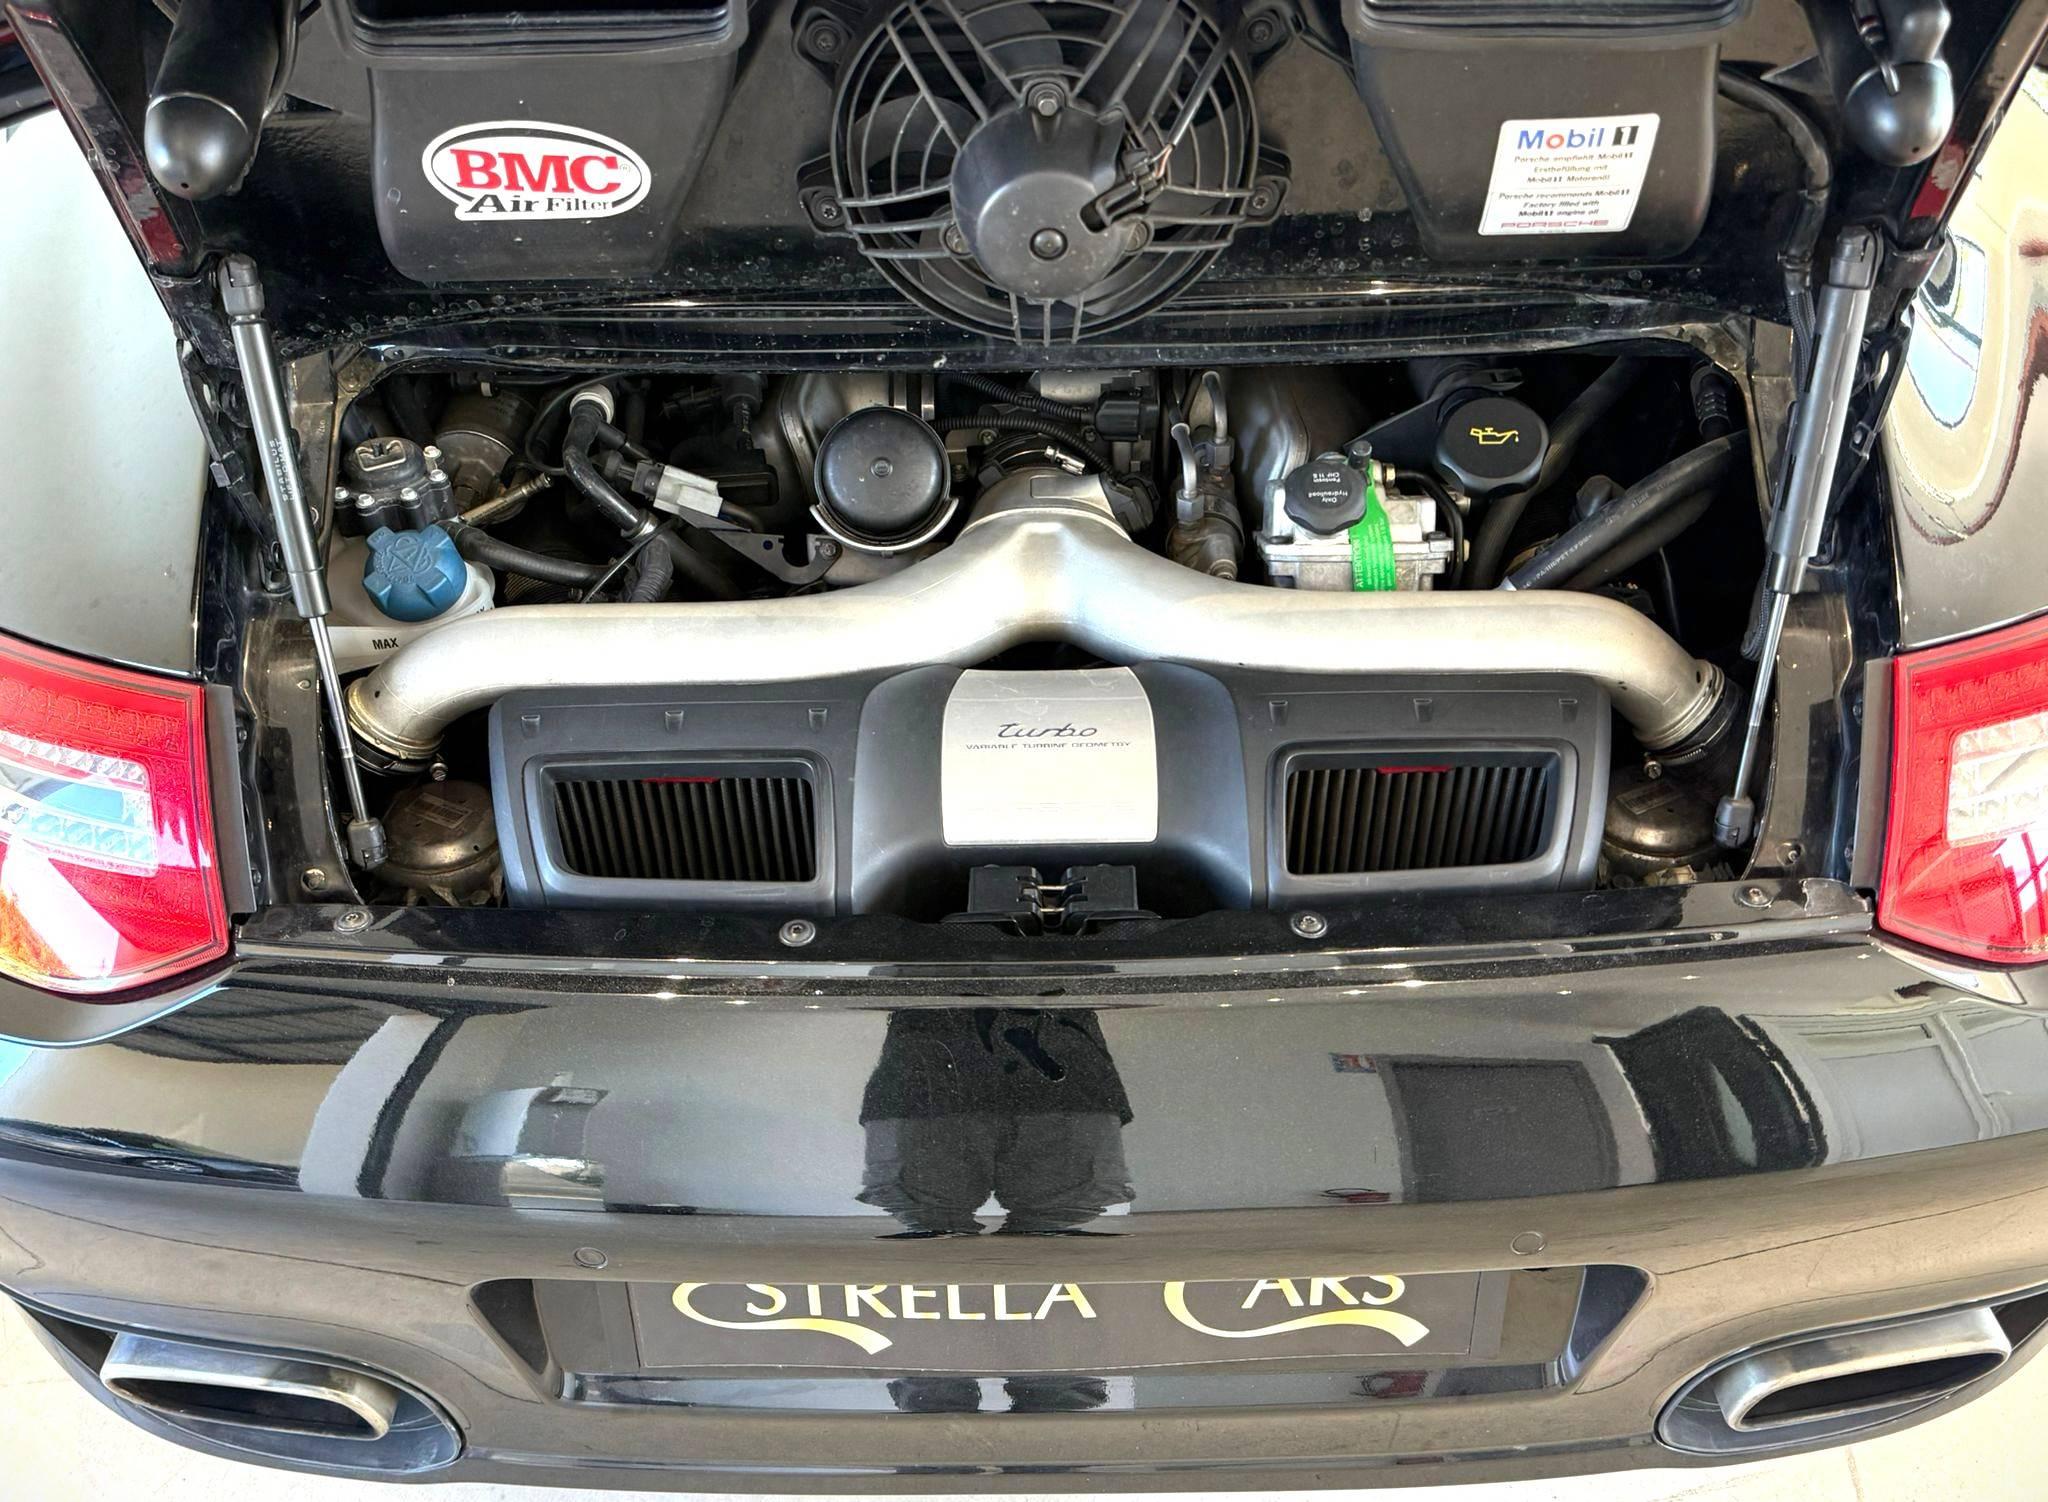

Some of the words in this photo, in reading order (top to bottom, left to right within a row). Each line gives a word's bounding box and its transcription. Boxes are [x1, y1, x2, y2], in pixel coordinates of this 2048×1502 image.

[1517, 128, 1605, 149] Mobil
[1612, 126, 1639, 146] 1
[1514, 155, 1550, 163] Porsche
[450, 149, 621, 195] BMC
[465, 194, 539, 214] Air
[545, 197, 613, 212] Filter
[1499, 192, 1534, 200] Porsche
[1501, 220, 1609, 228] PORSCHE
[269, 440, 289, 502] STABILUS
[372, 637, 399, 650] MAX
